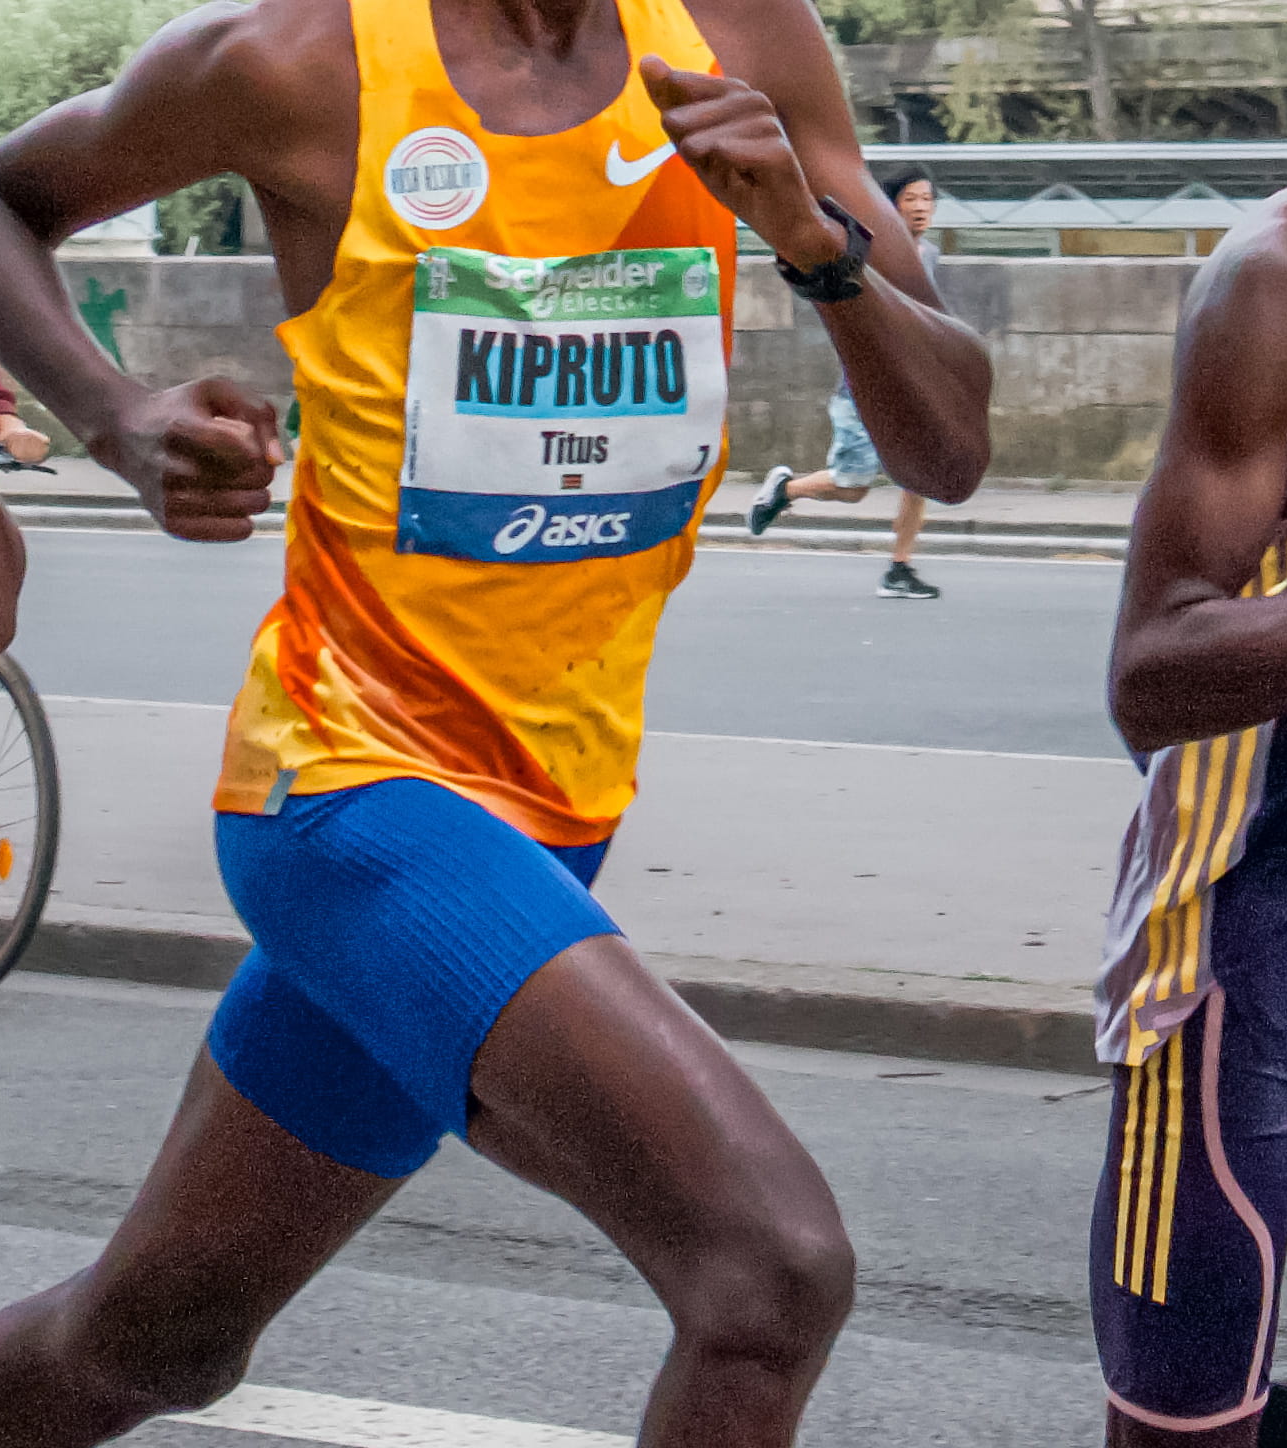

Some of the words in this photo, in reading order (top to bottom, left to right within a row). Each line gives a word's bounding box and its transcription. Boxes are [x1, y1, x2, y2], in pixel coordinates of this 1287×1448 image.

[485, 253, 663, 292] Schneider
[456, 328, 687, 406] KIPRUTO
[540, 430, 609, 465] Titus
[692, 444, 711, 475] 7
[540, 512, 632, 547] asics
